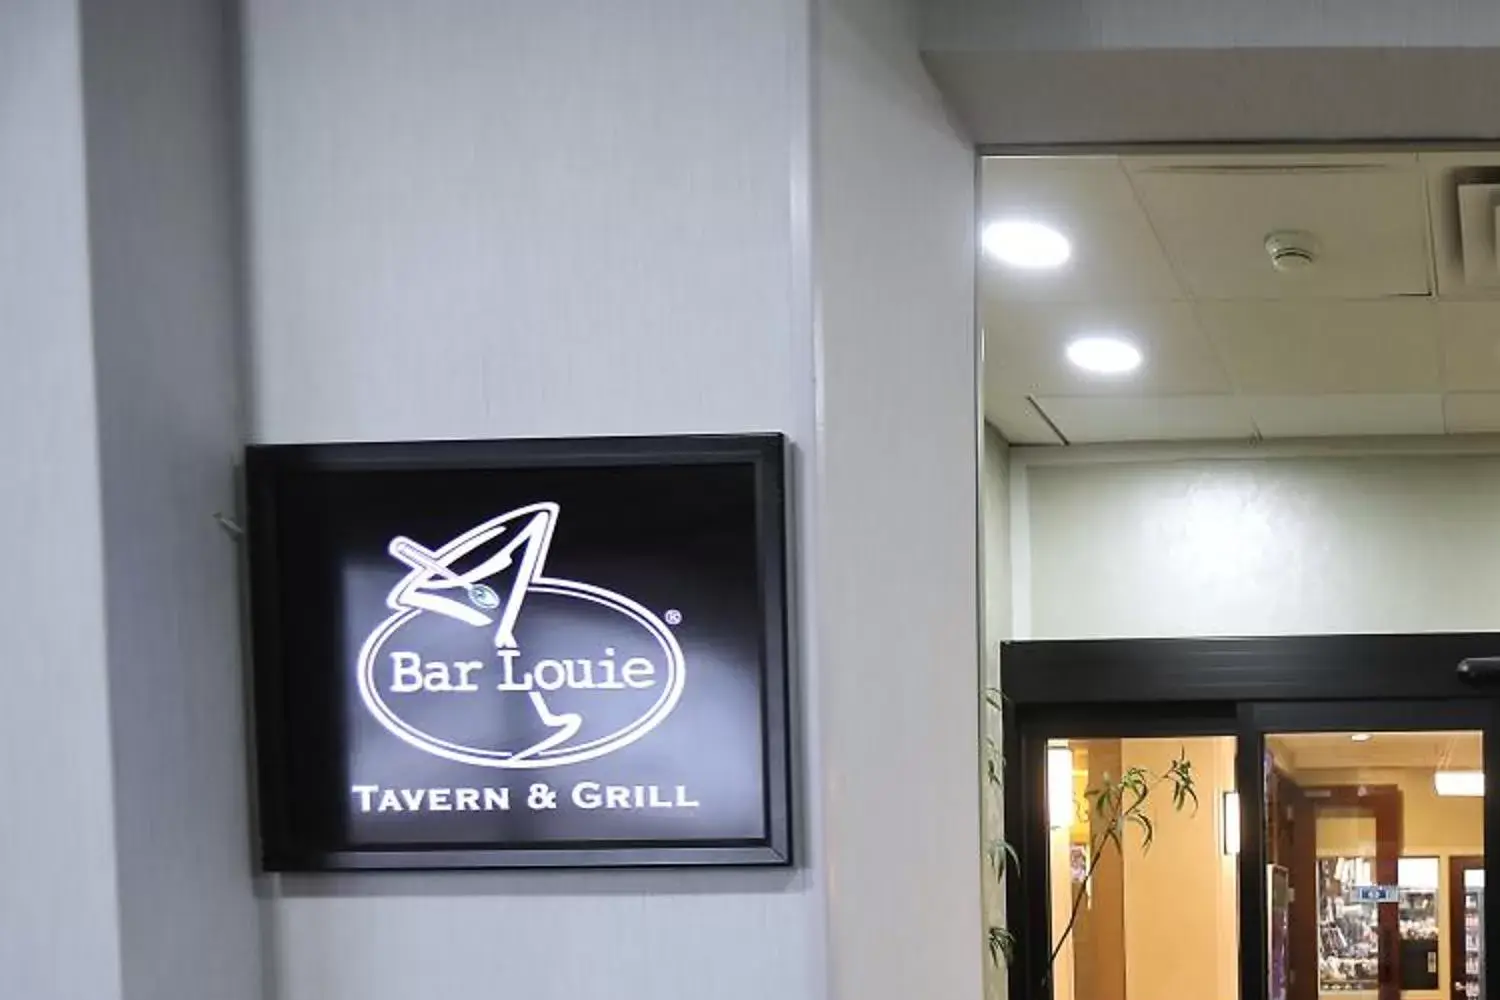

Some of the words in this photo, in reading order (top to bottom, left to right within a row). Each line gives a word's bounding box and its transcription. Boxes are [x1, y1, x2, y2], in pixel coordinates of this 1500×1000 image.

[390, 651, 483, 692] Bar
[497, 648, 656, 691] Louie
[351, 785, 511, 811] TAVERN
[527, 783, 557, 810] &
[571, 781, 700, 808] GRILL
